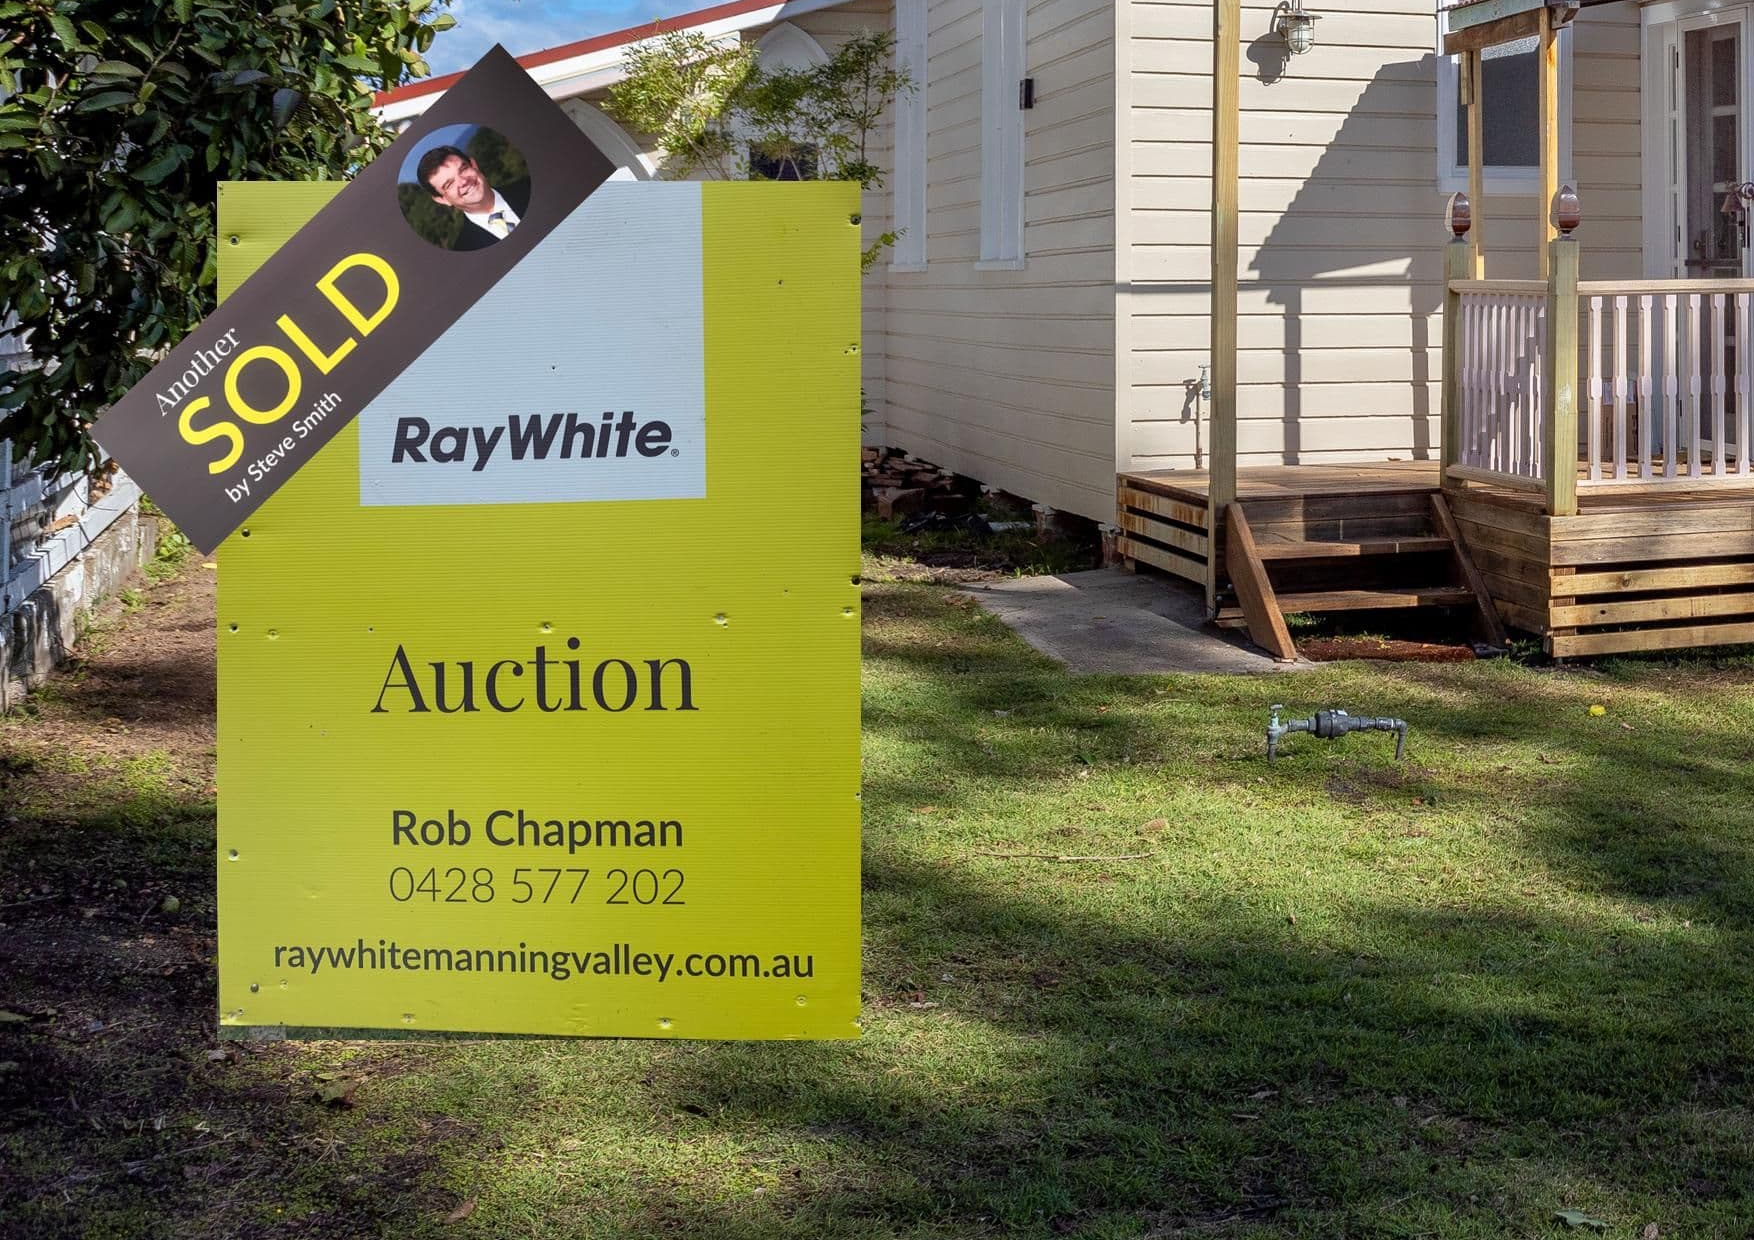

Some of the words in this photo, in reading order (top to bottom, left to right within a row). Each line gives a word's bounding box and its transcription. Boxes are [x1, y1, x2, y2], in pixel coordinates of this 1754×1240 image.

[155, 327, 240, 416] Another
[178, 253, 400, 475] SOLD
[225, 478, 251, 503] by
[247, 434, 296, 482] Steve
[292, 390, 342, 439] Smith
[370, 637, 700, 713] Auction
[392, 810, 472, 847] Rob
[485, 811, 683, 854] Chapman
[389, 867, 495, 903] 0428
[511, 868, 590, 904] 577
[606, 869, 686, 905] 202
[274, 939, 814, 982] raywhitemanningvalley.com.au
